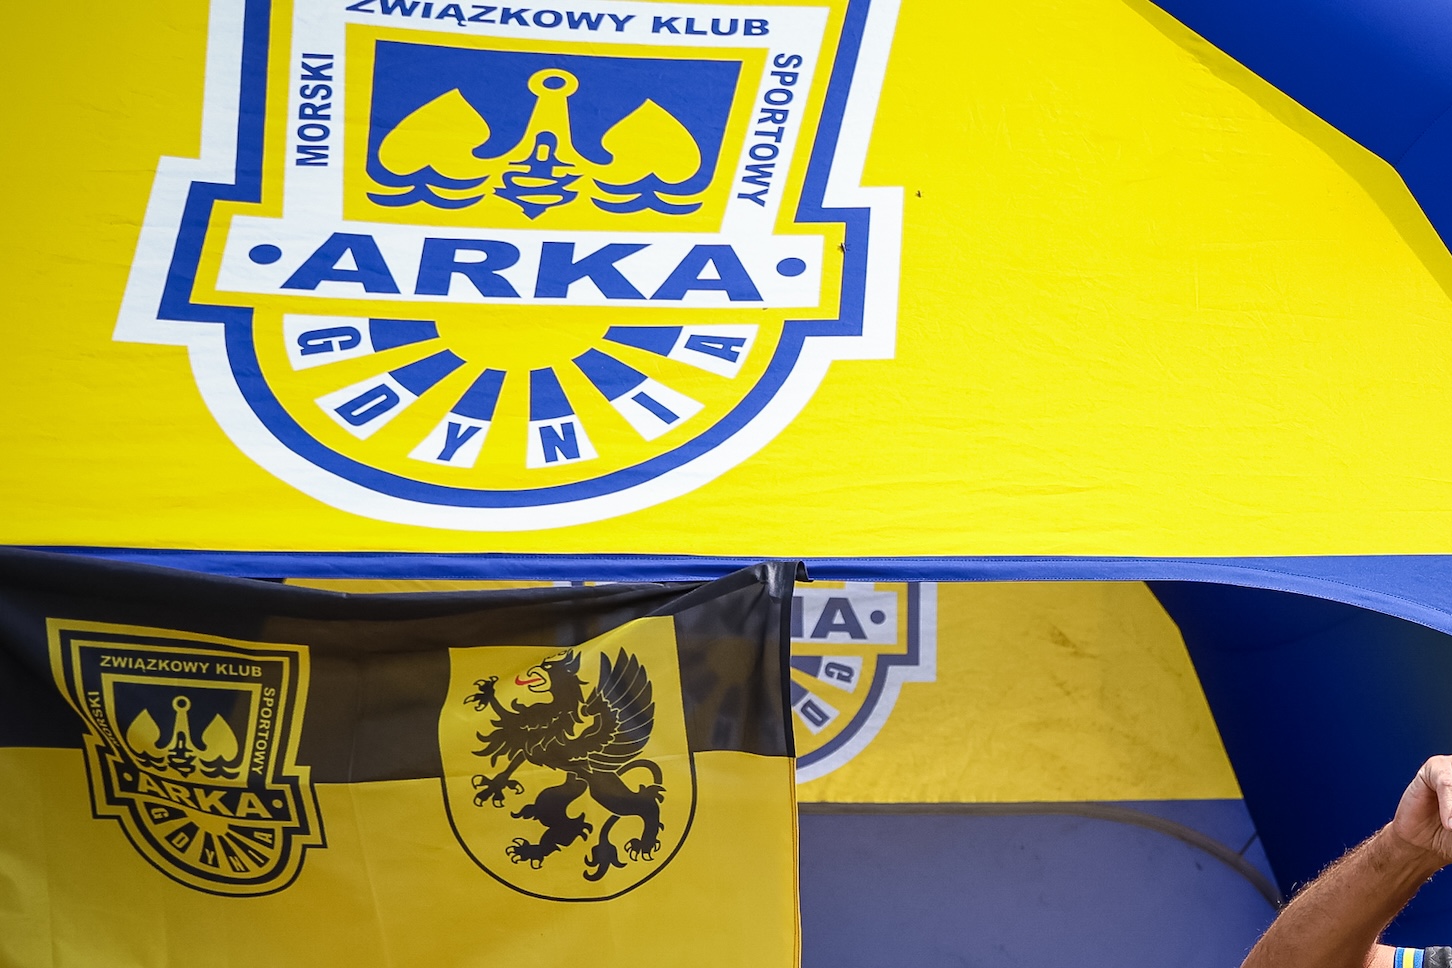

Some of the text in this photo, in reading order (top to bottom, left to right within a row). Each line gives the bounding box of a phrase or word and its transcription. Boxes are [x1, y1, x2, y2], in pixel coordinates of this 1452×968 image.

[651, 8, 770, 37] KLUB
[296, 53, 335, 167] MORSKI
[737, 53, 803, 208] SPORTOWY
[281, 231, 764, 302] ARKA
[298, 322, 748, 464] GDYNIA
[100, 655, 263, 678] ZWIĄZKOWY KLUB
[251, 687, 276, 775] SPORTOWY
[137, 772, 273, 819] ARKA
[151, 807, 273, 872] GDYNIA
